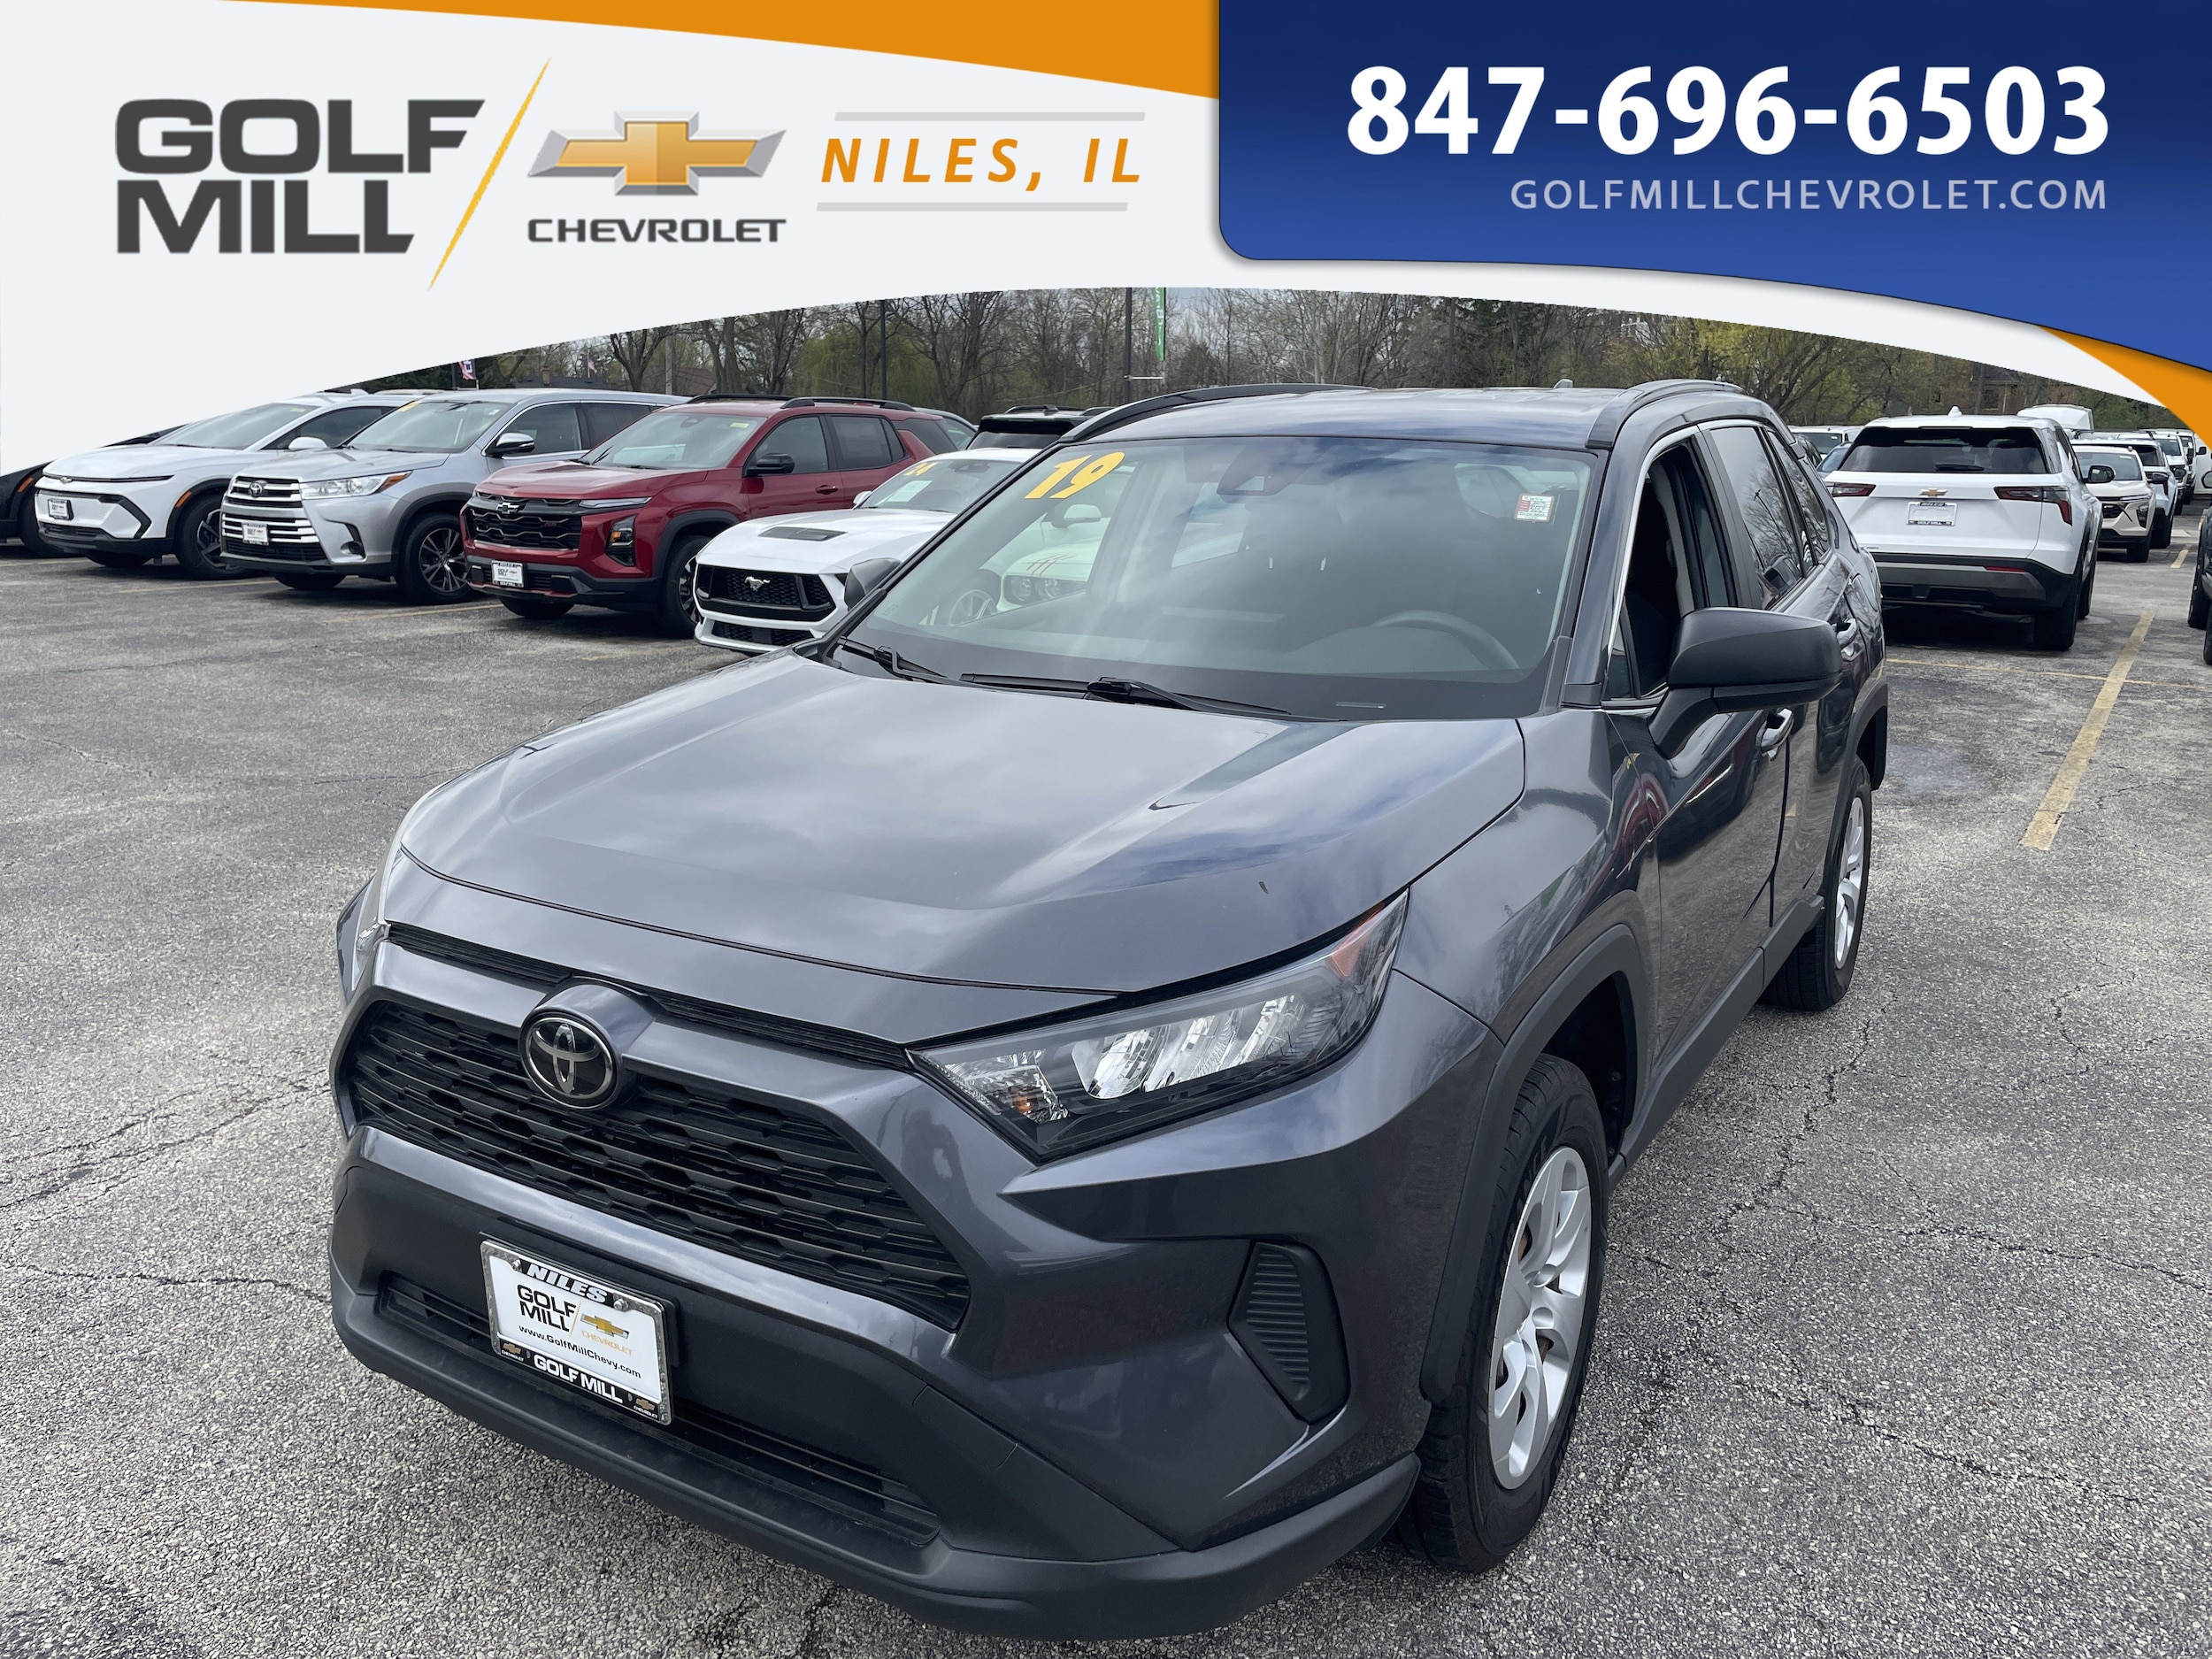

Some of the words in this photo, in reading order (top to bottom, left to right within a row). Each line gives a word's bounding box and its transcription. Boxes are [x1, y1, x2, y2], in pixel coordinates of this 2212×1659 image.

[1024, 451, 1125, 499] 19
[517, 1284, 577, 1318] GOLF
[526, 1263, 608, 1303] NILES
[518, 1300, 571, 1333] MILL
[518, 1325, 641, 1379] www.GolfMillChevy.com
[581, 1330, 634, 1356] CHEVROLET
[534, 1354, 580, 1383] GOLF
[580, 1372, 623, 1403] MILL
